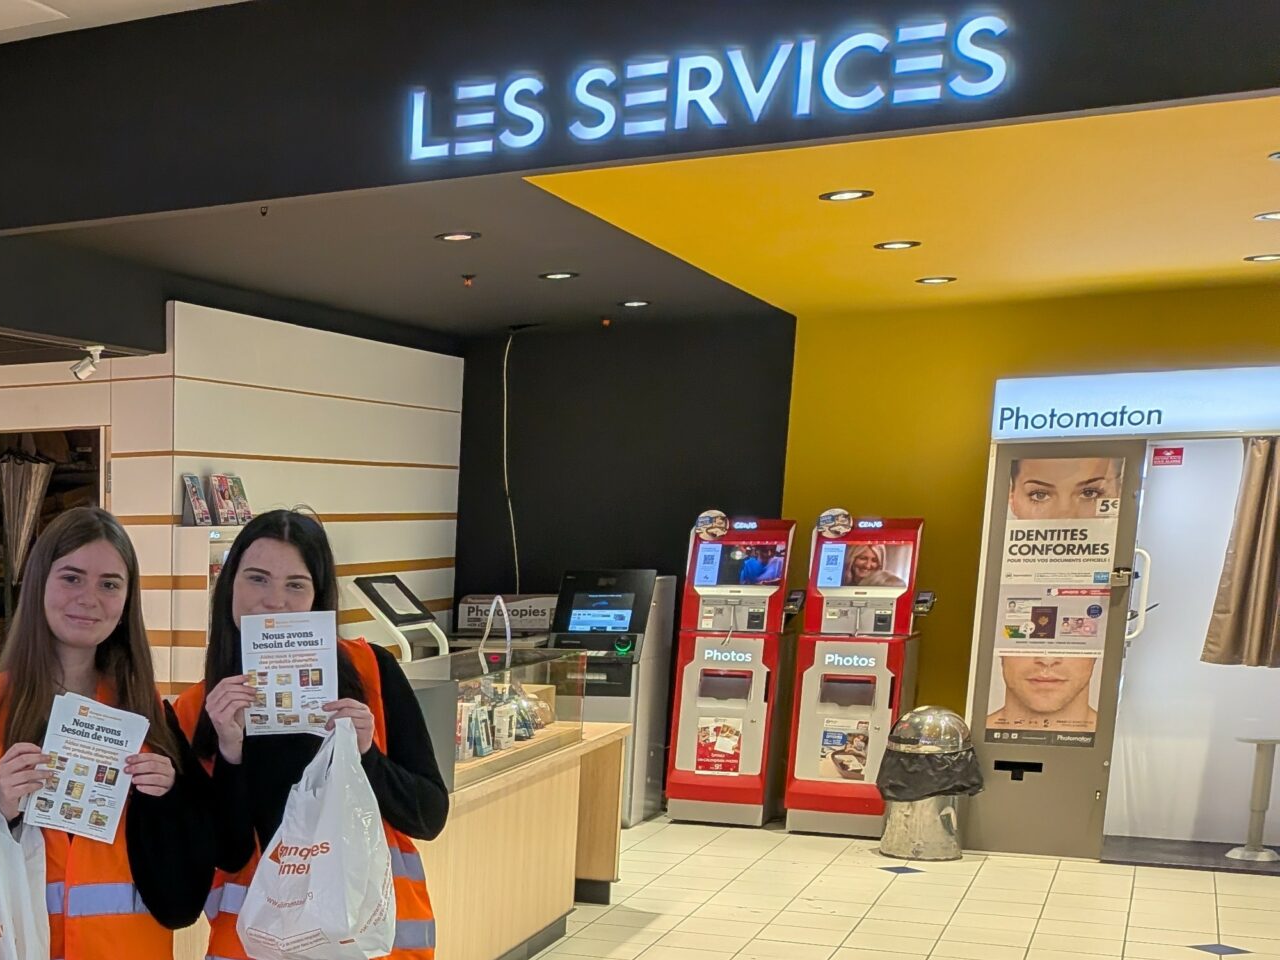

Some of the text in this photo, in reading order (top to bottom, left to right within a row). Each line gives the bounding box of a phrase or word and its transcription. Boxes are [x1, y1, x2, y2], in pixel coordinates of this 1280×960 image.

[410, 14, 1009, 161] LES SERVICES
[999, 405, 1162, 431] Photomaton
[1008, 543, 1110, 556] CONFORMES
[467, 605, 547, 618] Phoocopies
[261, 631, 314, 640] Nous avons
[252, 641, 283, 650] besoin
[284, 640, 296, 648] de
[704, 649, 752, 662] Photos
[825, 654, 876, 667] Photos
[72, 718, 121, 736] Nous avons
[61, 724, 90, 738] besoin
[91, 732, 102, 741] de
[104, 736, 124, 746] vous
[1057, 734, 1092, 743] Photomaton
